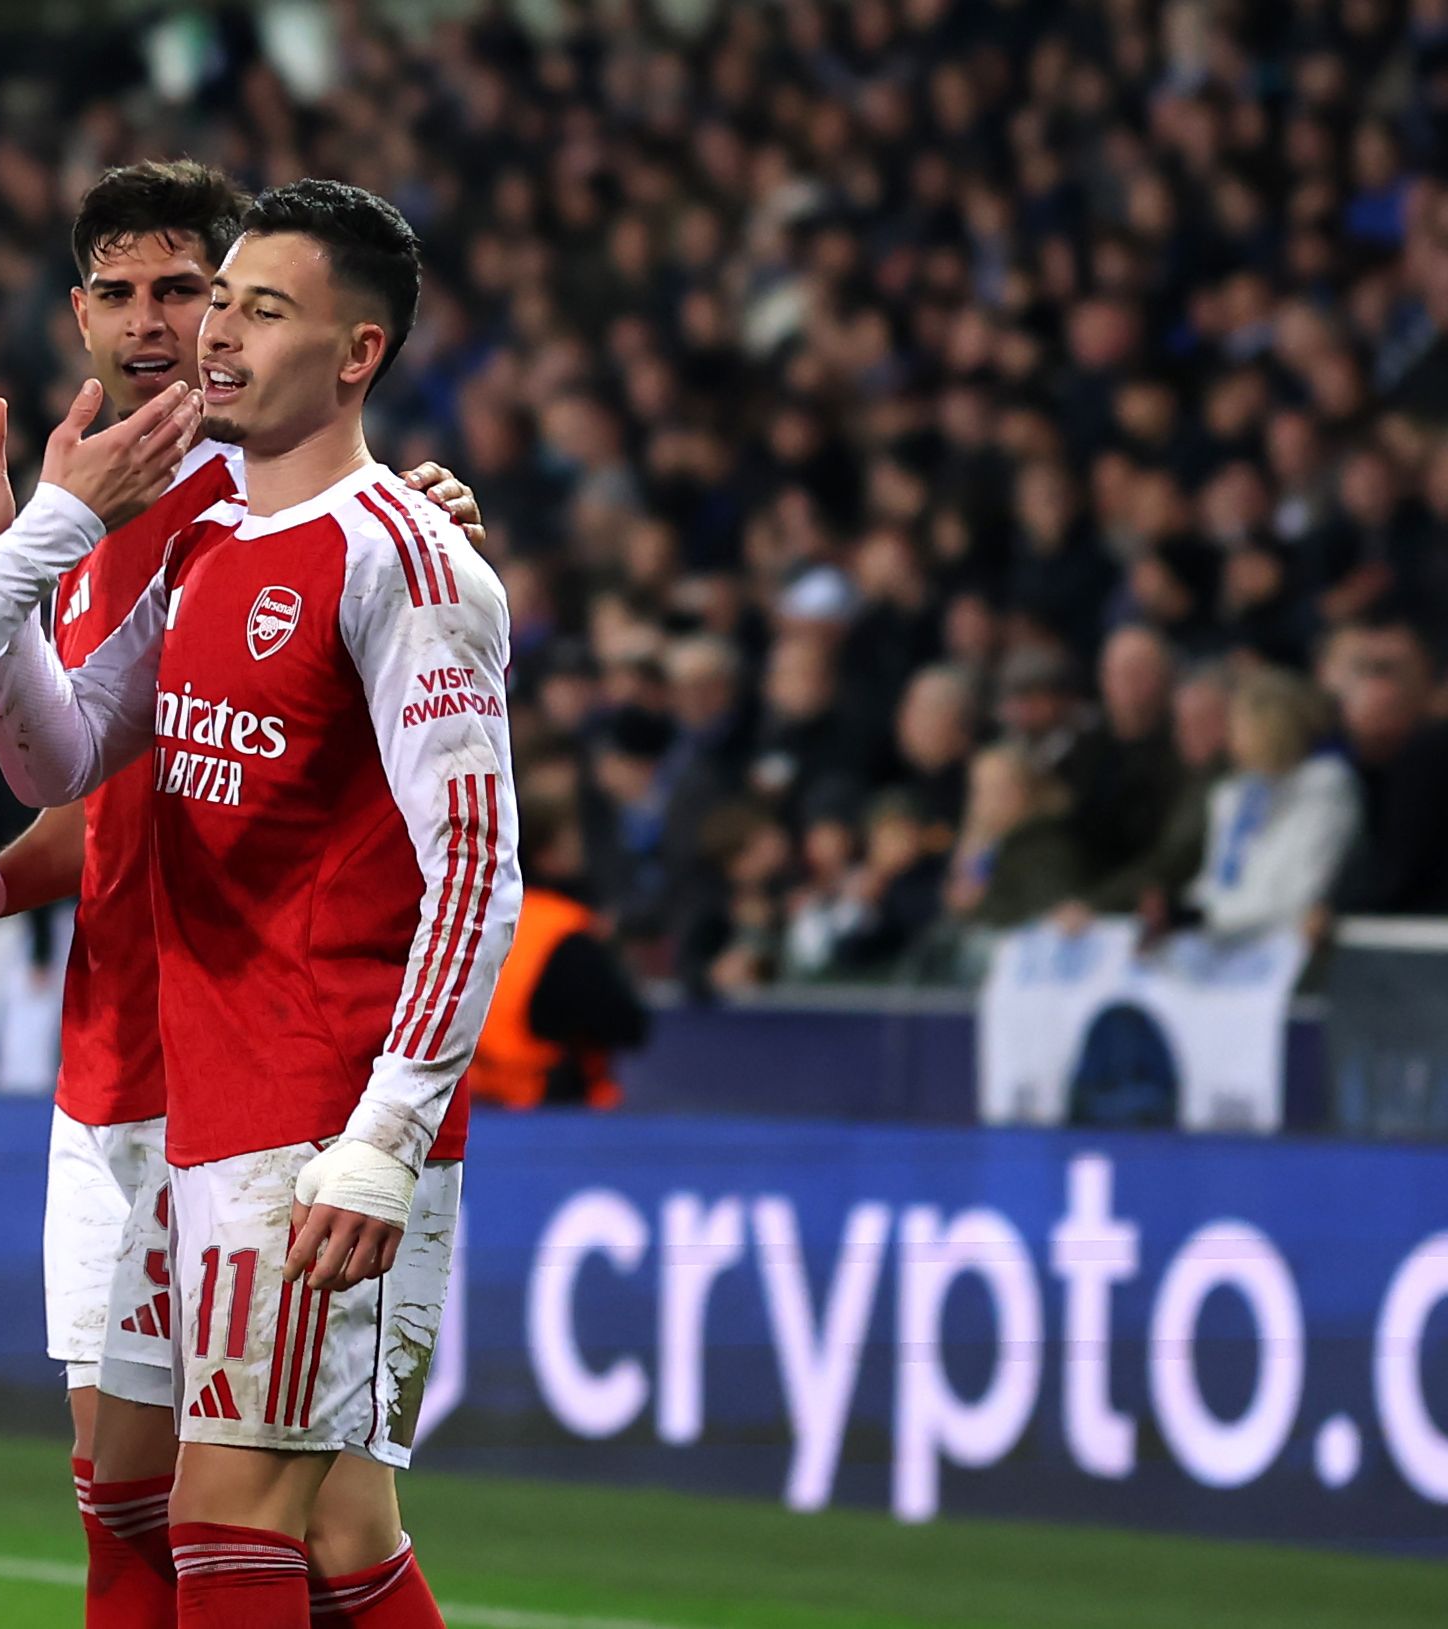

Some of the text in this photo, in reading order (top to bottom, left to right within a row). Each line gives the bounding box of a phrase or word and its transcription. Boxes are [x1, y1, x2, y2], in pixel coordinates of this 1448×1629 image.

[261, 596, 297, 616] Arsenal
[417, 666, 475, 694] VISIT
[155, 680, 287, 759] mirates
[403, 692, 502, 729] RWANDA
[195, 1245, 260, 1371] 11
